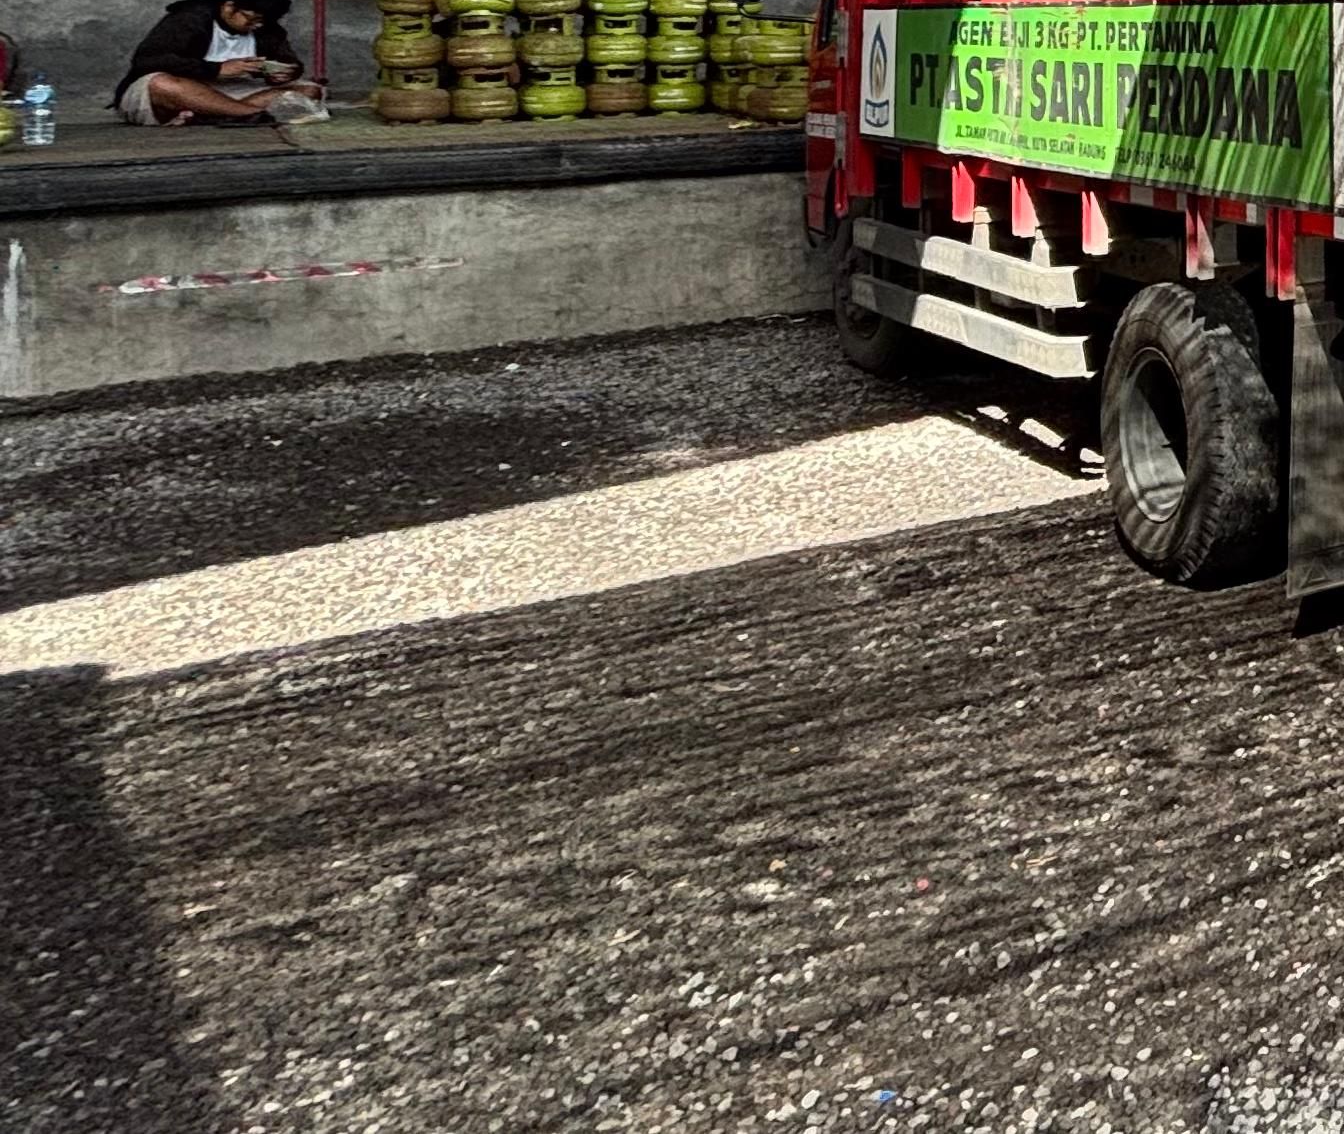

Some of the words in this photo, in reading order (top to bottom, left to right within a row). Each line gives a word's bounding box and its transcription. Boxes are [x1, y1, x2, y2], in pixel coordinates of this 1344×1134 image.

[947, 20, 995, 47] AGEN
[1034, 21, 1045, 49] 3
[1105, 21, 1218, 55] PERTAMINA
[909, 52, 944, 109] PT.
[1029, 59, 1106, 128] SARI
[1115, 62, 1303, 150] PERDANA
